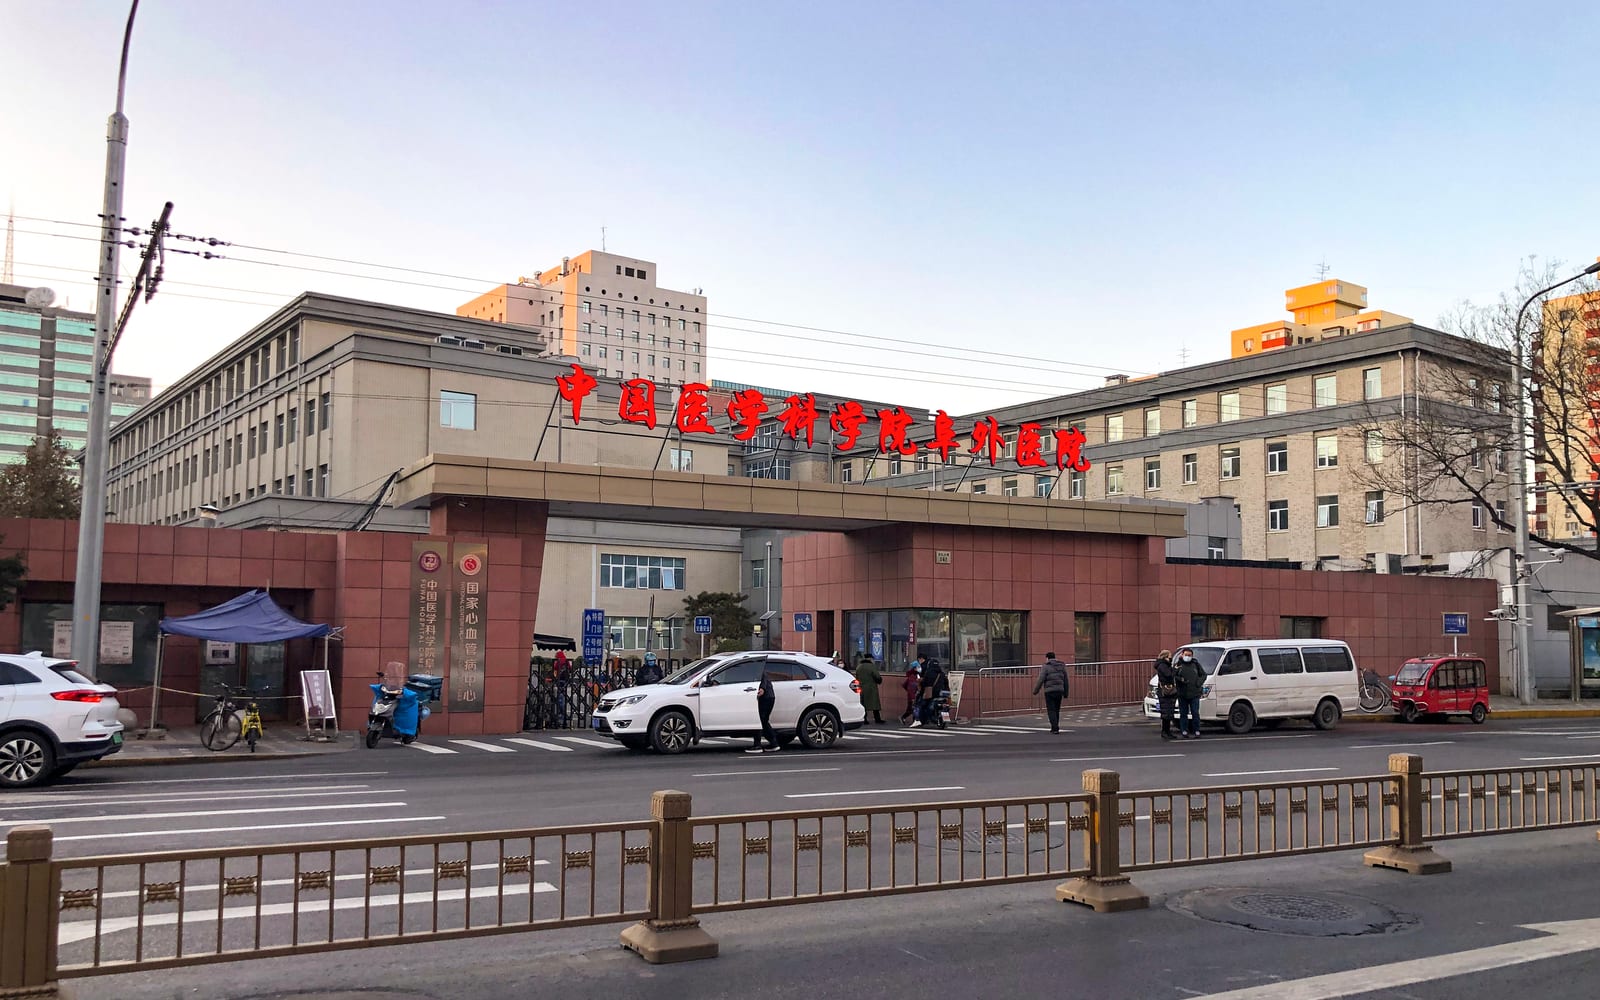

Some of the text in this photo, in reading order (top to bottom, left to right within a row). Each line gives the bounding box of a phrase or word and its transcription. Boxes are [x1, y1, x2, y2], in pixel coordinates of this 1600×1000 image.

[556, 364, 1091, 471] 中国医学科学院阜外医院
[463, 582, 479, 702] 国家心血管病中心
